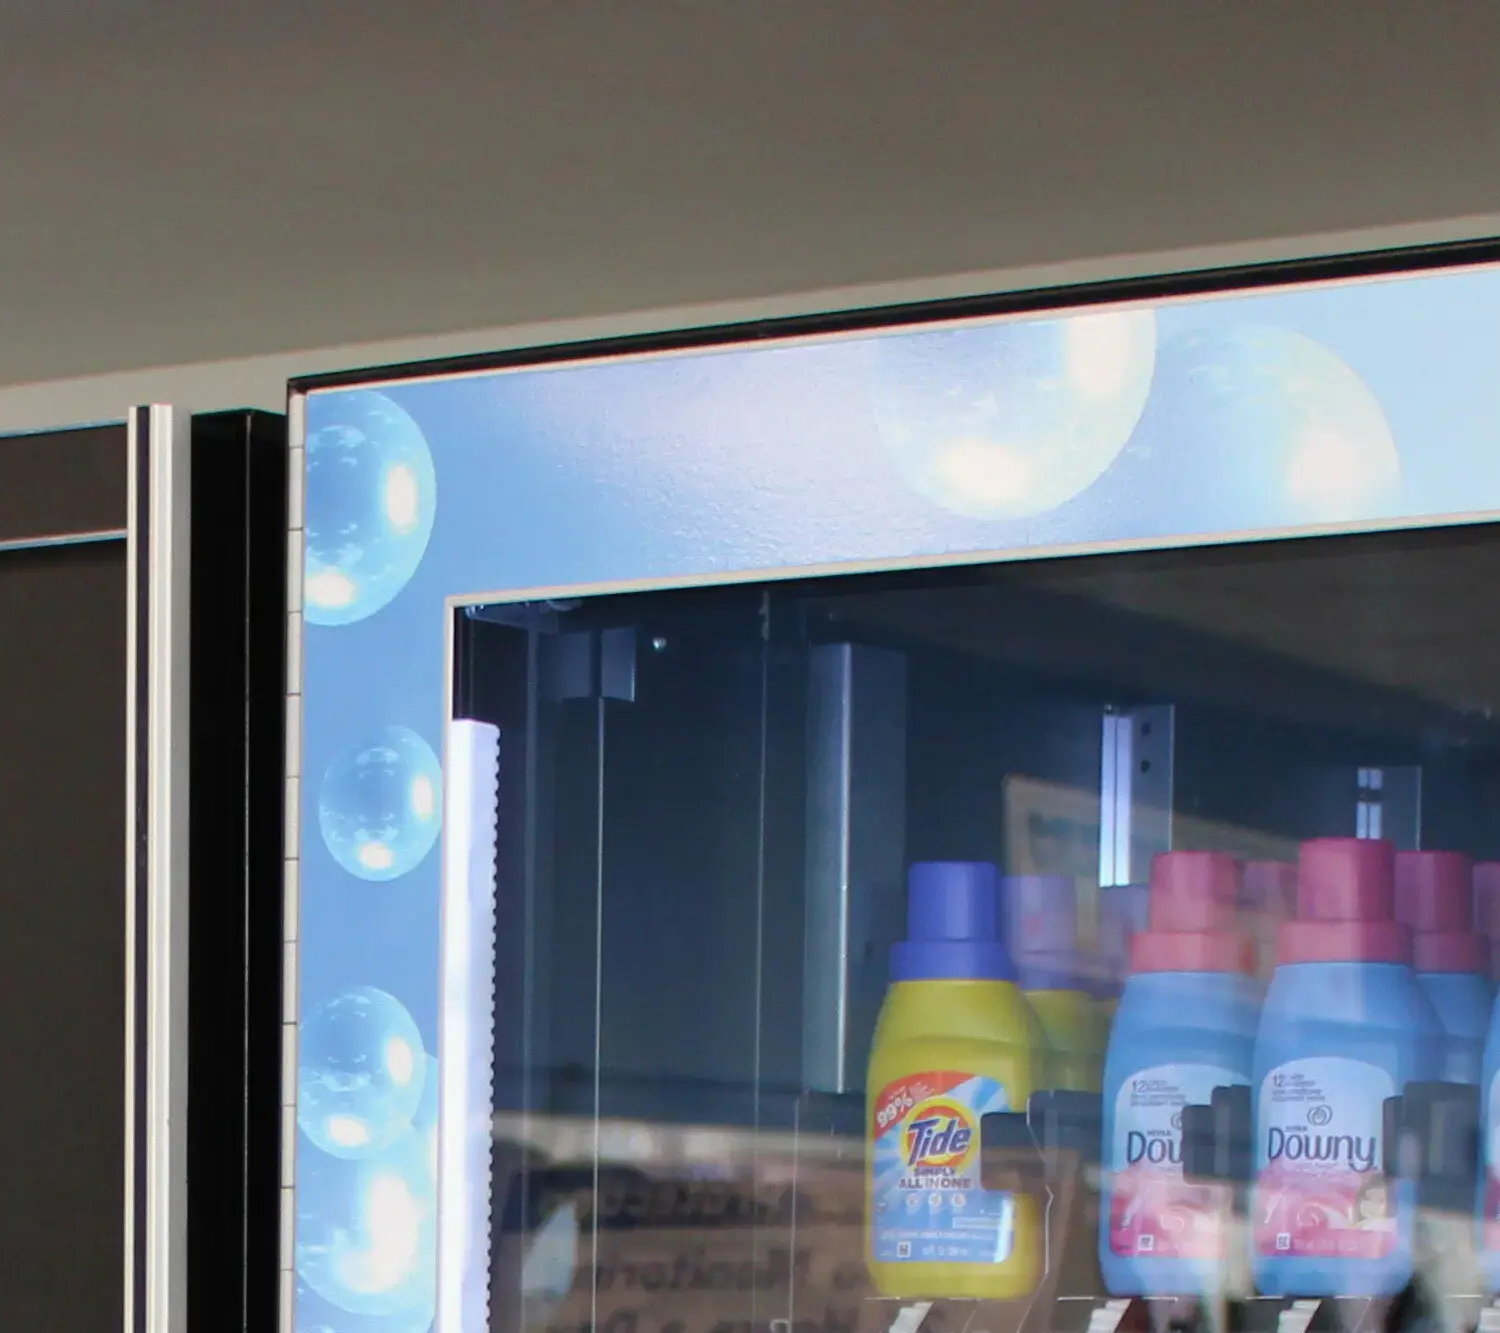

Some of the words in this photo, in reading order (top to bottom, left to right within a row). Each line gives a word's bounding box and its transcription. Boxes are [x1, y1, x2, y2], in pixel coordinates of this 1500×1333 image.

[877, 1086, 914, 1127] 99%
[907, 1115, 972, 1167] Tide
[1267, 1126, 1377, 1173] Downy
[900, 1177, 923, 1188] ALL
